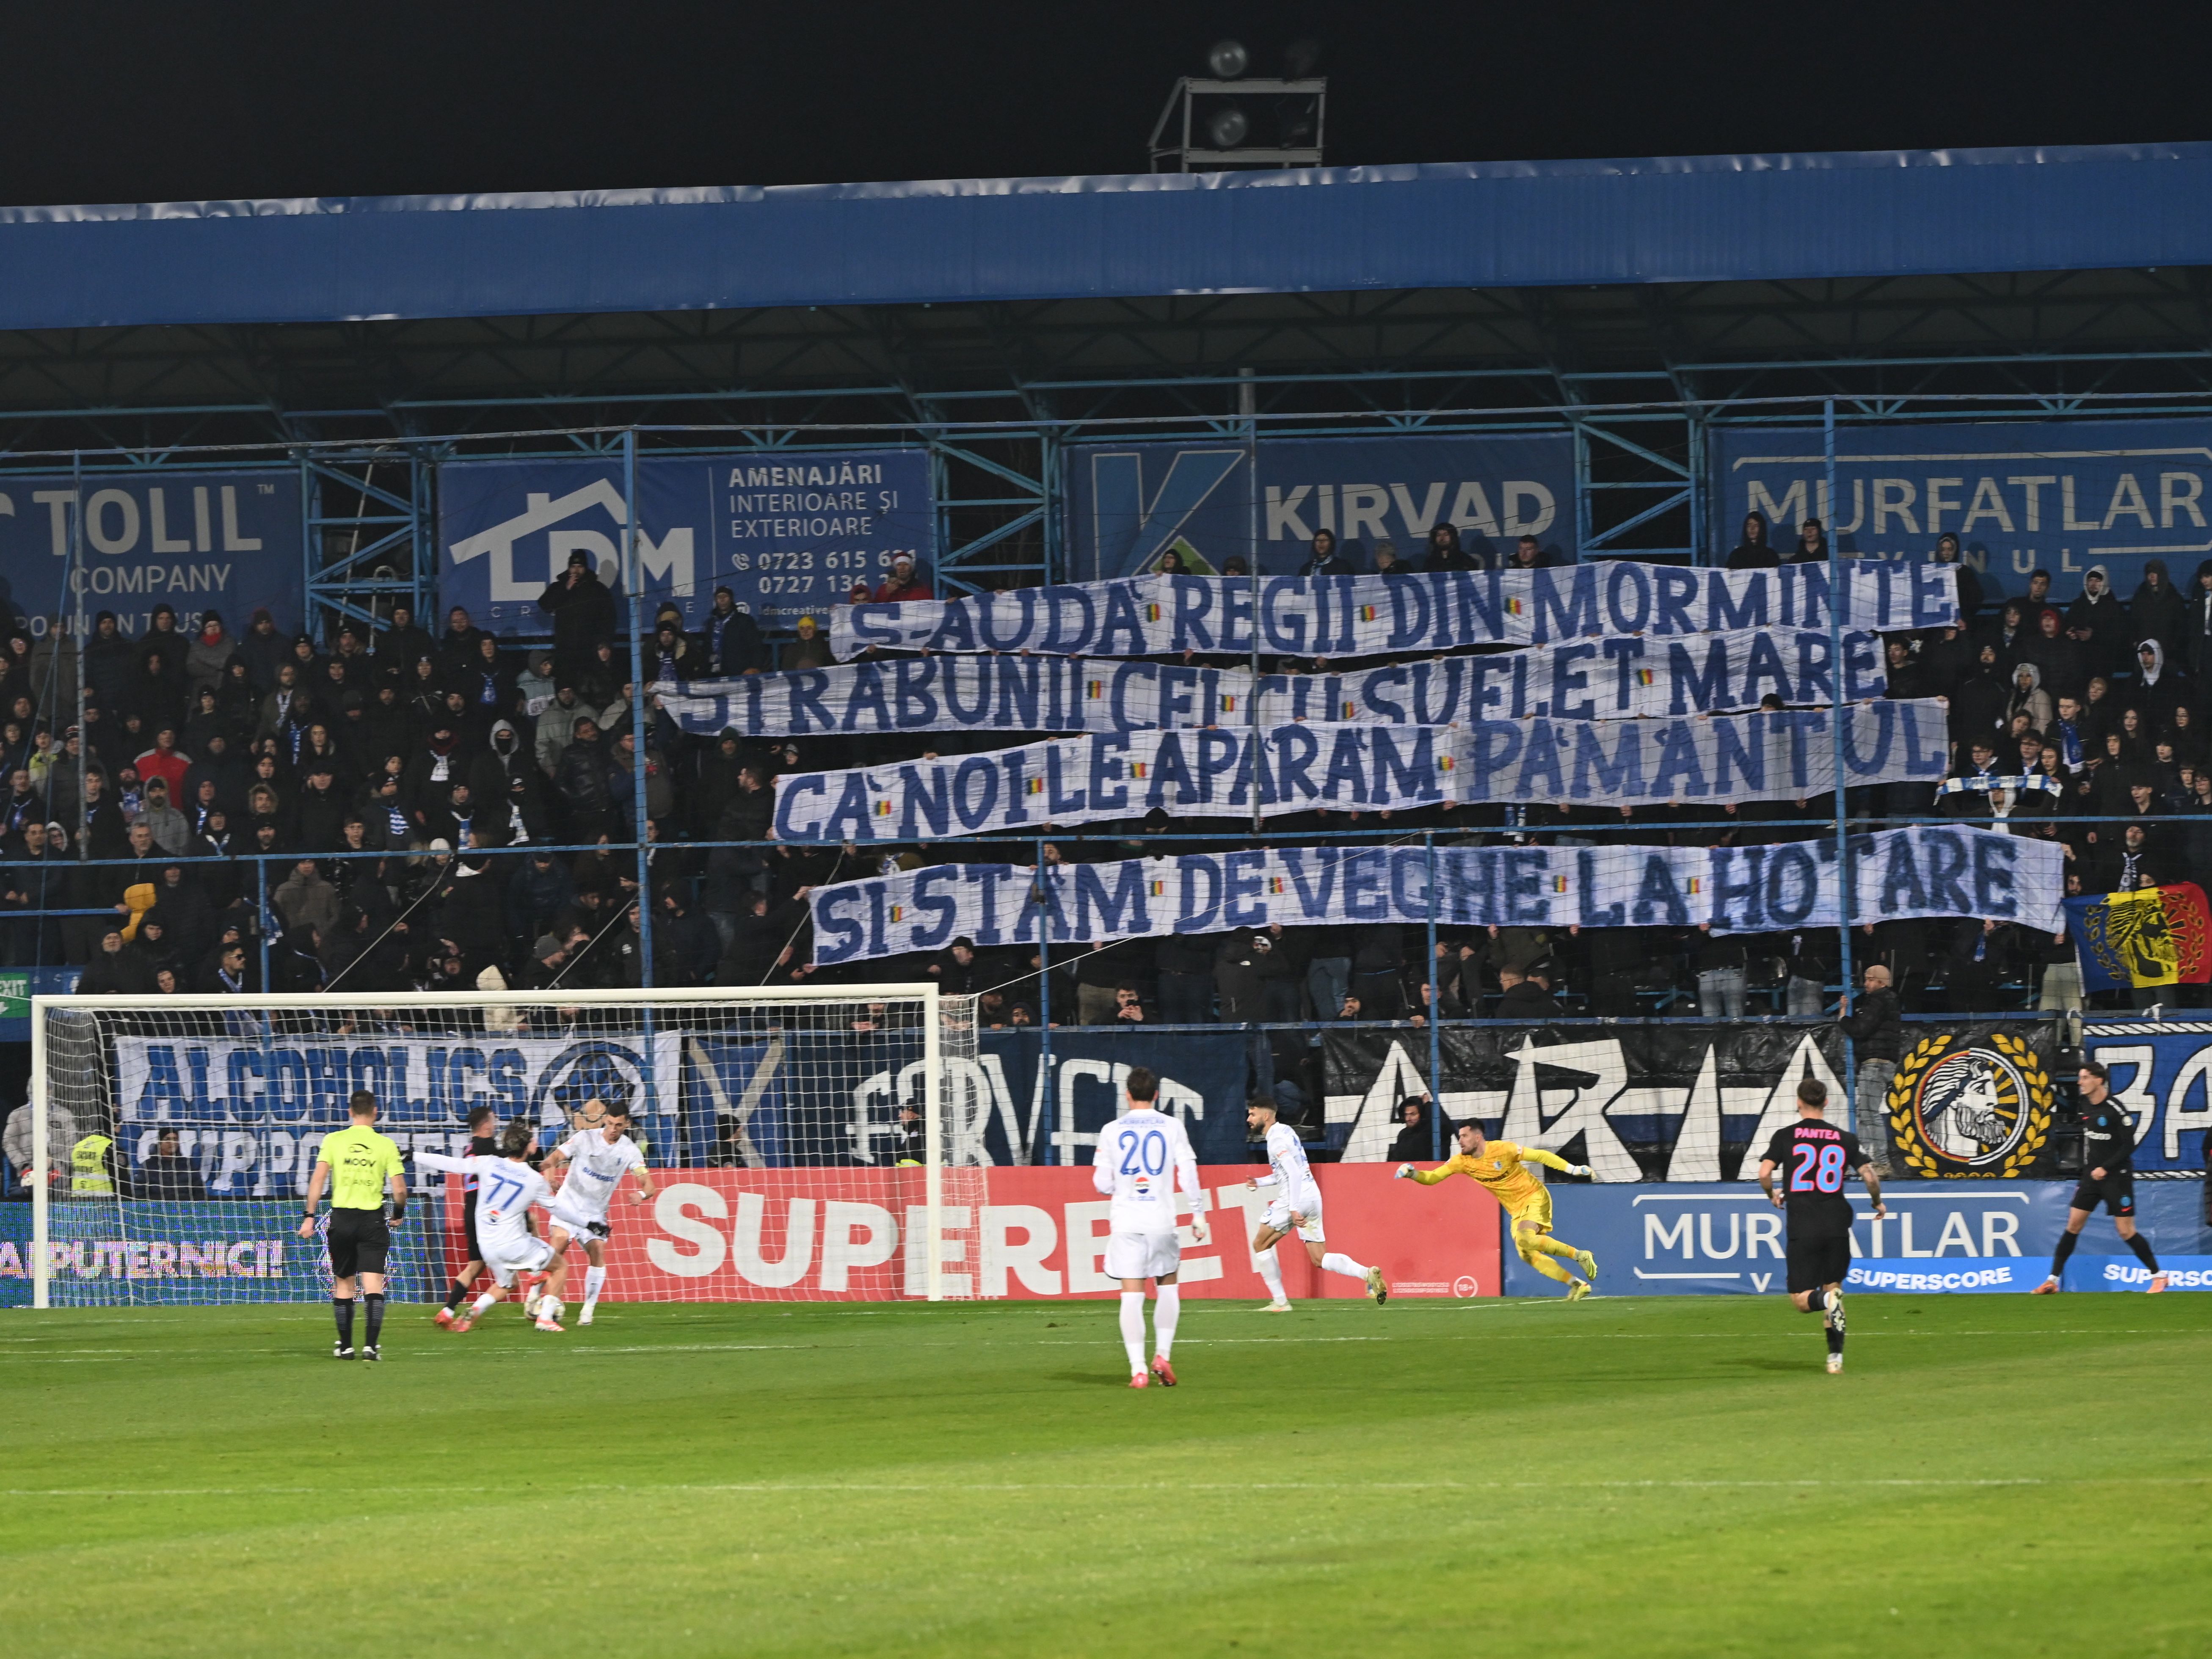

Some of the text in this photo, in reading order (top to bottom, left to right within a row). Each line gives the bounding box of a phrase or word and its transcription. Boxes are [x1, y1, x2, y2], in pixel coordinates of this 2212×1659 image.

[729, 461, 882, 488] AMENAJĂRI
[32, 485, 262, 556] TOLIL
[730, 491, 868, 513] INTERIOARE
[1265, 480, 1556, 540] KIRVAD
[1747, 471, 2209, 536] MURFATLAR
[732, 516, 873, 538] EXTERIOARE
[70, 563, 232, 594] COMPANY
[758, 551, 814, 570] 0723
[825, 551, 867, 568] 615
[759, 576, 814, 594] 0727
[1172, 574, 1354, 654] REGII
[1382, 568, 1505, 649] DIN
[1531, 559, 1960, 645] MORMINTE
[1111, 661, 1219, 731] CEI
[1668, 631, 1884, 715] MARE
[899, 750, 1029, 838] NOI
[1047, 733, 1129, 815] LE
[1178, 854, 1267, 930] DE
[1278, 847, 1550, 924] VEGHE
[1578, 848, 1688, 926] LA
[1708, 826, 2019, 928] HOTARE
[136, 1045, 527, 1122] ALCOHOLICS
[1118, 1130, 1167, 1176] 20
[1794, 1127, 1841, 1141] PANTEA
[486, 1173, 525, 1210] 77
[1790, 1143, 1846, 1193] 28
[646, 1183, 1281, 1296] SUPERBET
[1644, 1211, 2023, 1259] MURTLAR
[1846, 1266, 2013, 1290] SUPERSCORE
[2103, 1264, 2212, 1287] SUPRSC
